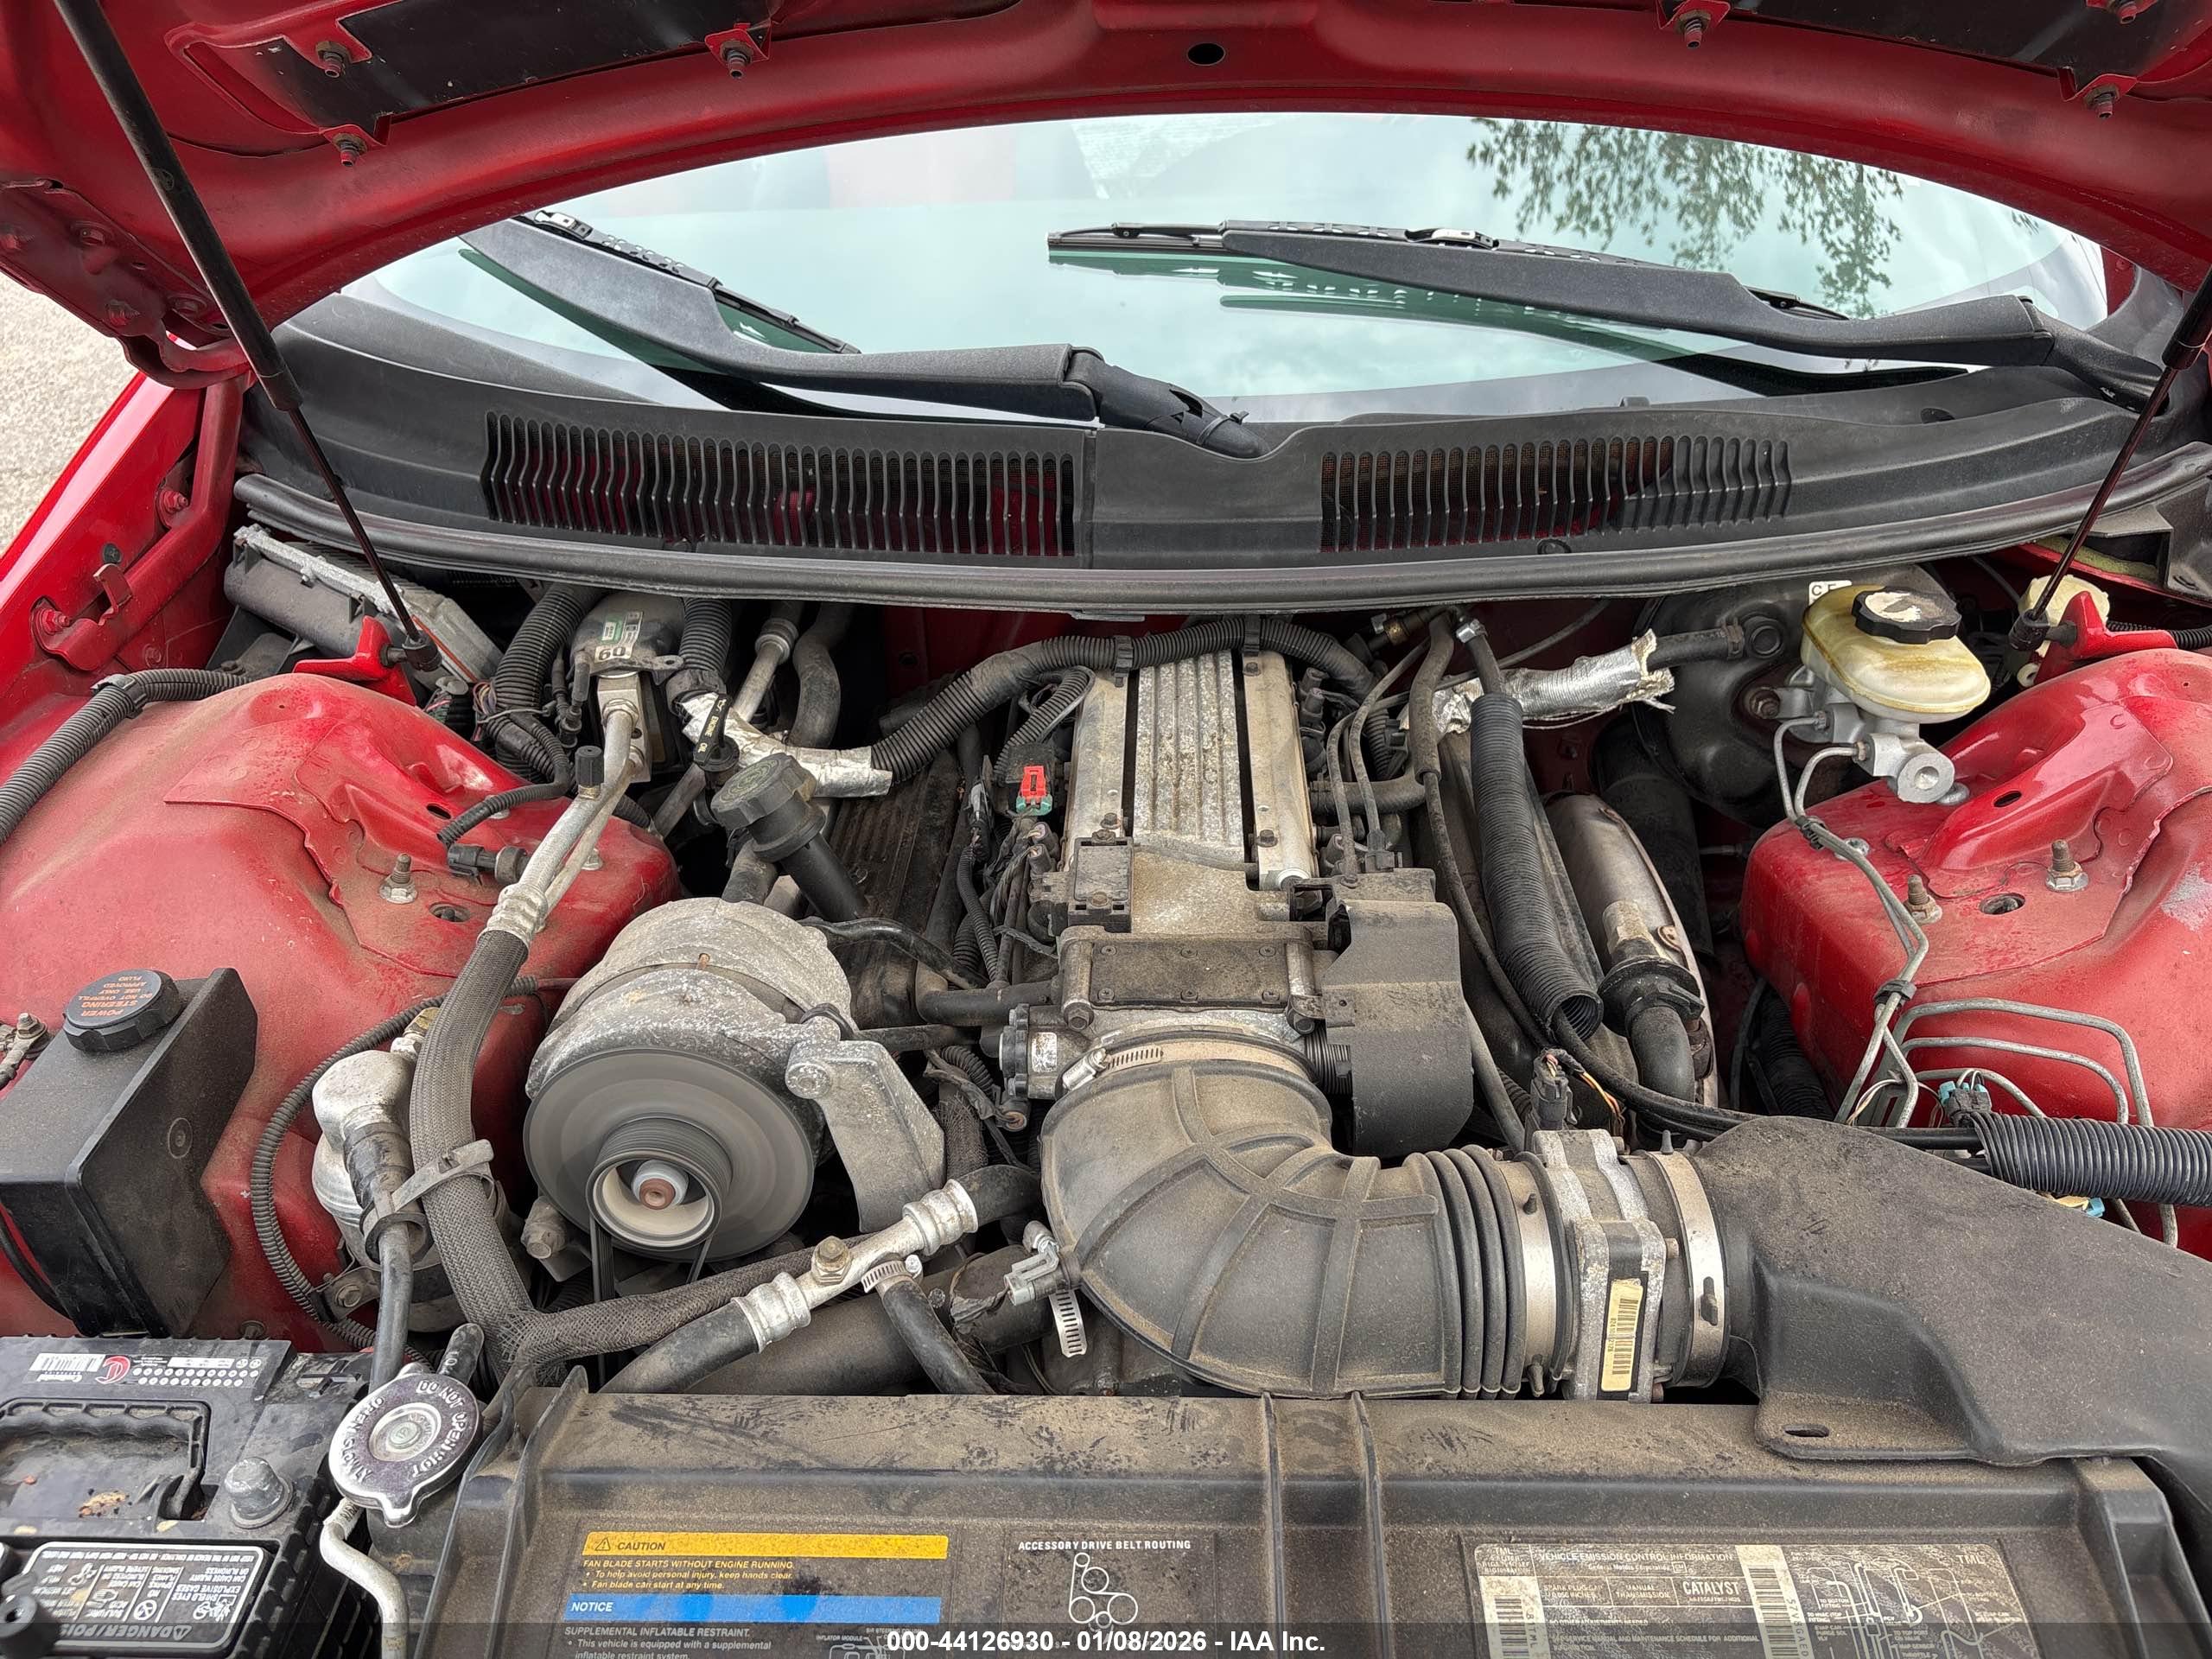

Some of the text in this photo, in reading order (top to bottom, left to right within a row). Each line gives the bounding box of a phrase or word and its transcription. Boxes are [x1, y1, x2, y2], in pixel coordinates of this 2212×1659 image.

[698, 715, 719, 753] ENGINE OIL
[416, 1380, 440, 1395] DO
[439, 1387, 466, 1408] NOT
[441, 1411, 467, 1452] OPEN
[412, 1451, 445, 1478] HOT
[617, 1541, 666, 1551] CAUTION
[1018, 1540, 1192, 1551] ACCESSORY DRIVE BELT ROUTING
[1956, 1554, 1986, 1564] TML
[583, 1560, 601, 1568] FAN
[602, 1560, 633, 1568] BLADE
[752, 1560, 795, 1569] RUNNING.
[627, 1571, 651, 1580] avoid
[652, 1571, 690, 1580] personal
[691, 1571, 716, 1580] injury,
[718, 1571, 740, 1580] keep
[741, 1571, 768, 1580] hands
[175, 1584, 241, 1593] EXPLOSIVE GASES
[591, 1581, 725, 1590] Fan blade can start at any time.
[1682, 1581, 1739, 1595] CATALYST
[171, 1592, 218, 1601] SHIELD EYES
[571, 1601, 613, 1612] NOTICE
[564, 1627, 638, 1636] SUPPLEMENTAL
[639, 1627, 695, 1636] INFLATABLE
[577, 1639, 595, 1648] This
[598, 1639, 628, 1648] vehicle
[631, 1639, 639, 1648] is
[640, 1640, 681, 1649] equipped
[683, 1640, 702, 1649] with
[712, 1641, 772, 1650] supplemental
[575, 1650, 615, 1659] inflatable
